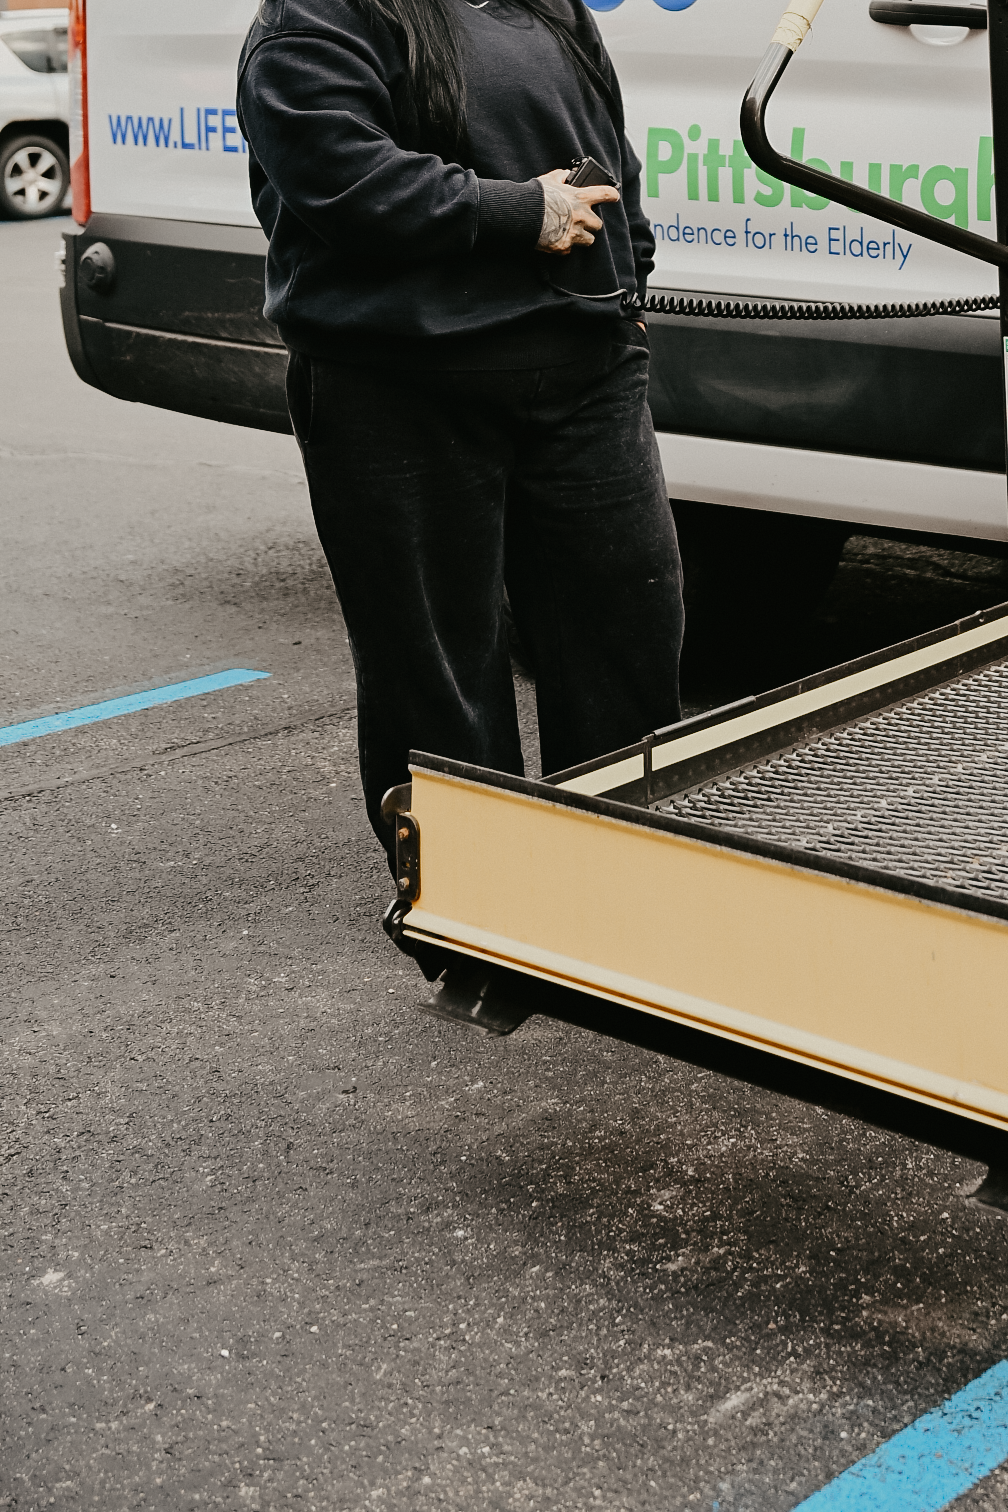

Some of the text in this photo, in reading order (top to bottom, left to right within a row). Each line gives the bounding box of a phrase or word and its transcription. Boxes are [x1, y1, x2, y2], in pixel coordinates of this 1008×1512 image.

[107, 106, 247, 154] www.LIFE
[653, 213, 913, 271] ndence for the Elderly
